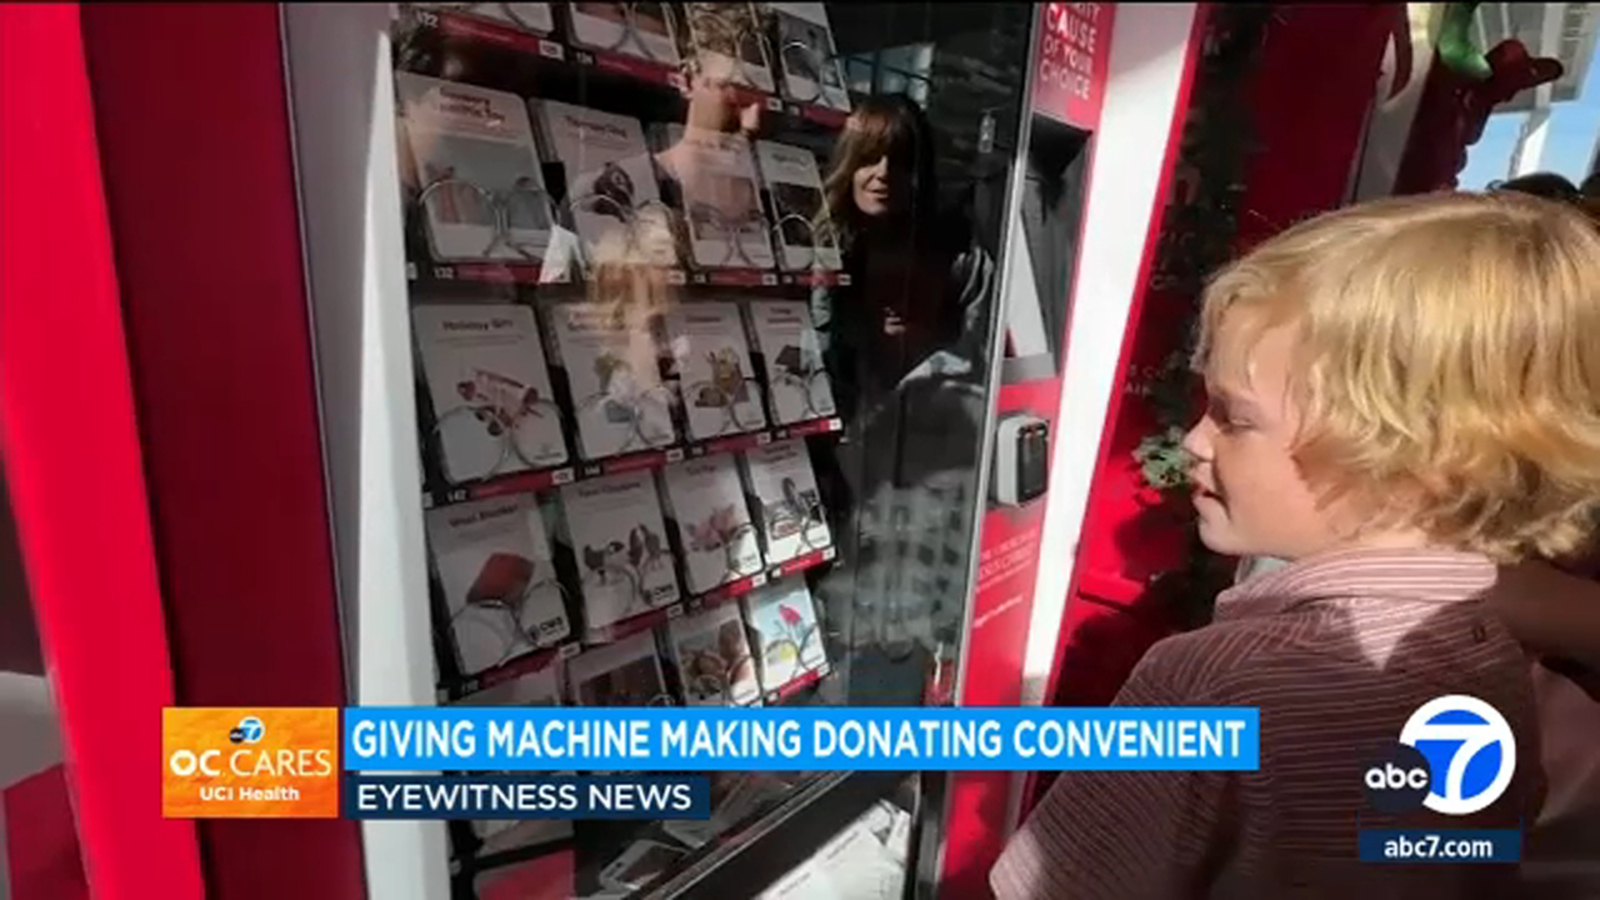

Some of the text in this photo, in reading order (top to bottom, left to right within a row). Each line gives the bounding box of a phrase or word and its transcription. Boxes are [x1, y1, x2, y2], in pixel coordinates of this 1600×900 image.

[1046, 5, 1097, 54] CAUSE
[1043, 34, 1093, 76] OF YOUR
[1040, 58, 1091, 101] CHOICE
